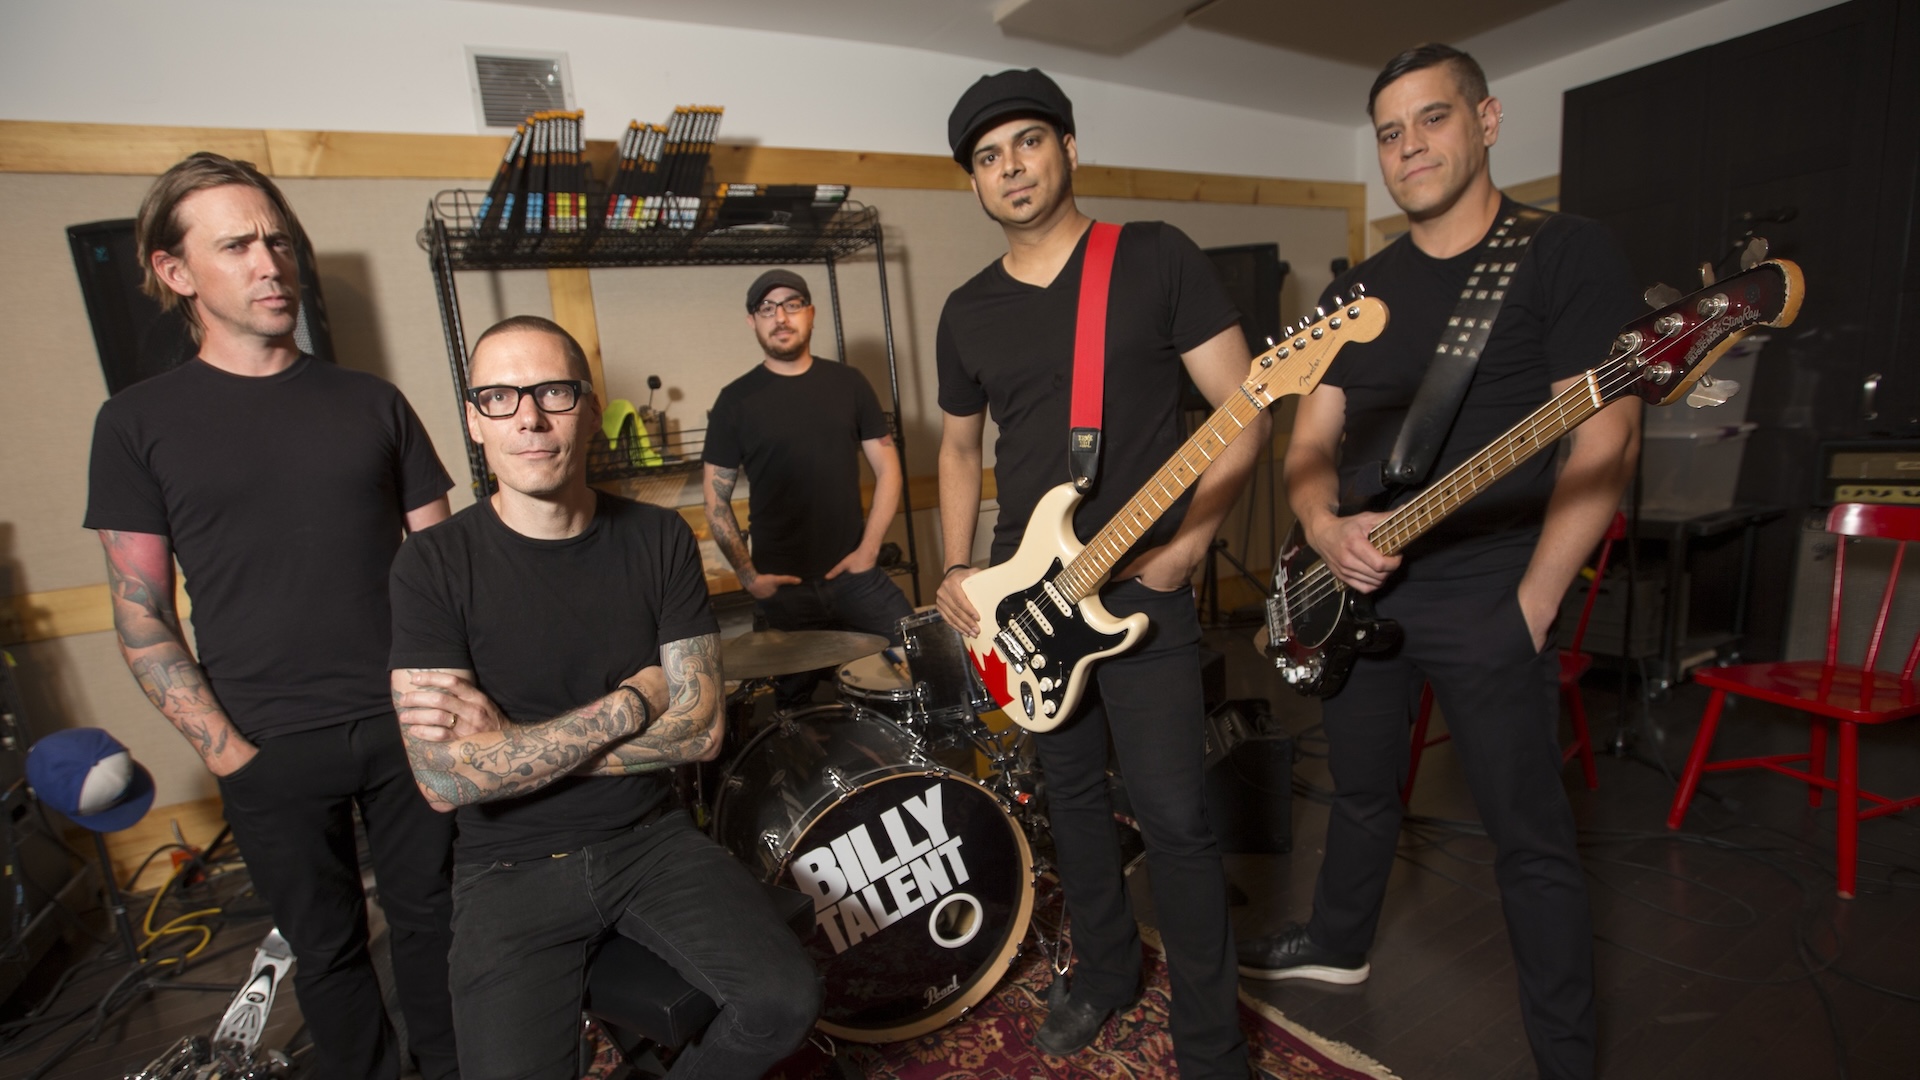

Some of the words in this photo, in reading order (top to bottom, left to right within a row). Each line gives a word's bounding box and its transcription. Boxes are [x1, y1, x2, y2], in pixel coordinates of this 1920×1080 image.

[1299, 359, 1321, 387] Fender
[790, 783, 949, 911] BILLY
[816, 835, 970, 955] TALENT
[922, 974, 960, 1010] Pearl
